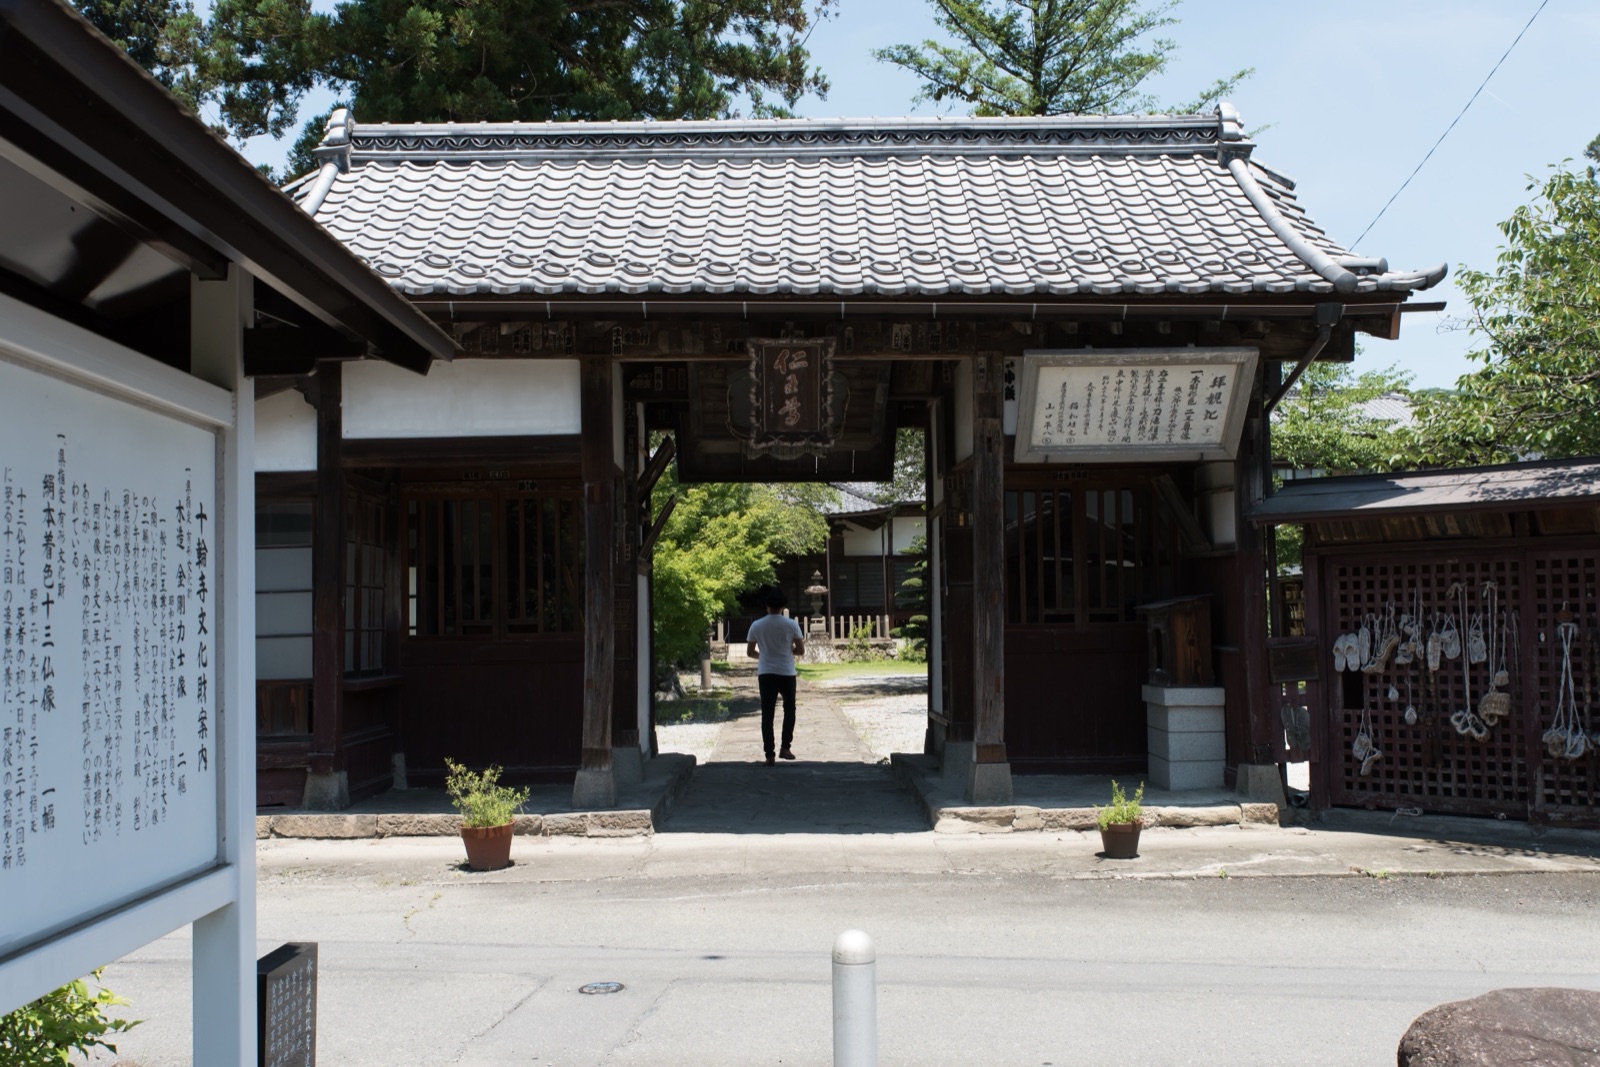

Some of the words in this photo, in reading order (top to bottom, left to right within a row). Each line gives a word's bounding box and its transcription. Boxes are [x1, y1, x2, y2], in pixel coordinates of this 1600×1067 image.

[41, 473, 56, 712] 絹本着色十三仏像
[195, 502, 208, 772] 十輪寺文化財案内
[42, 786, 56, 832] 一幅
